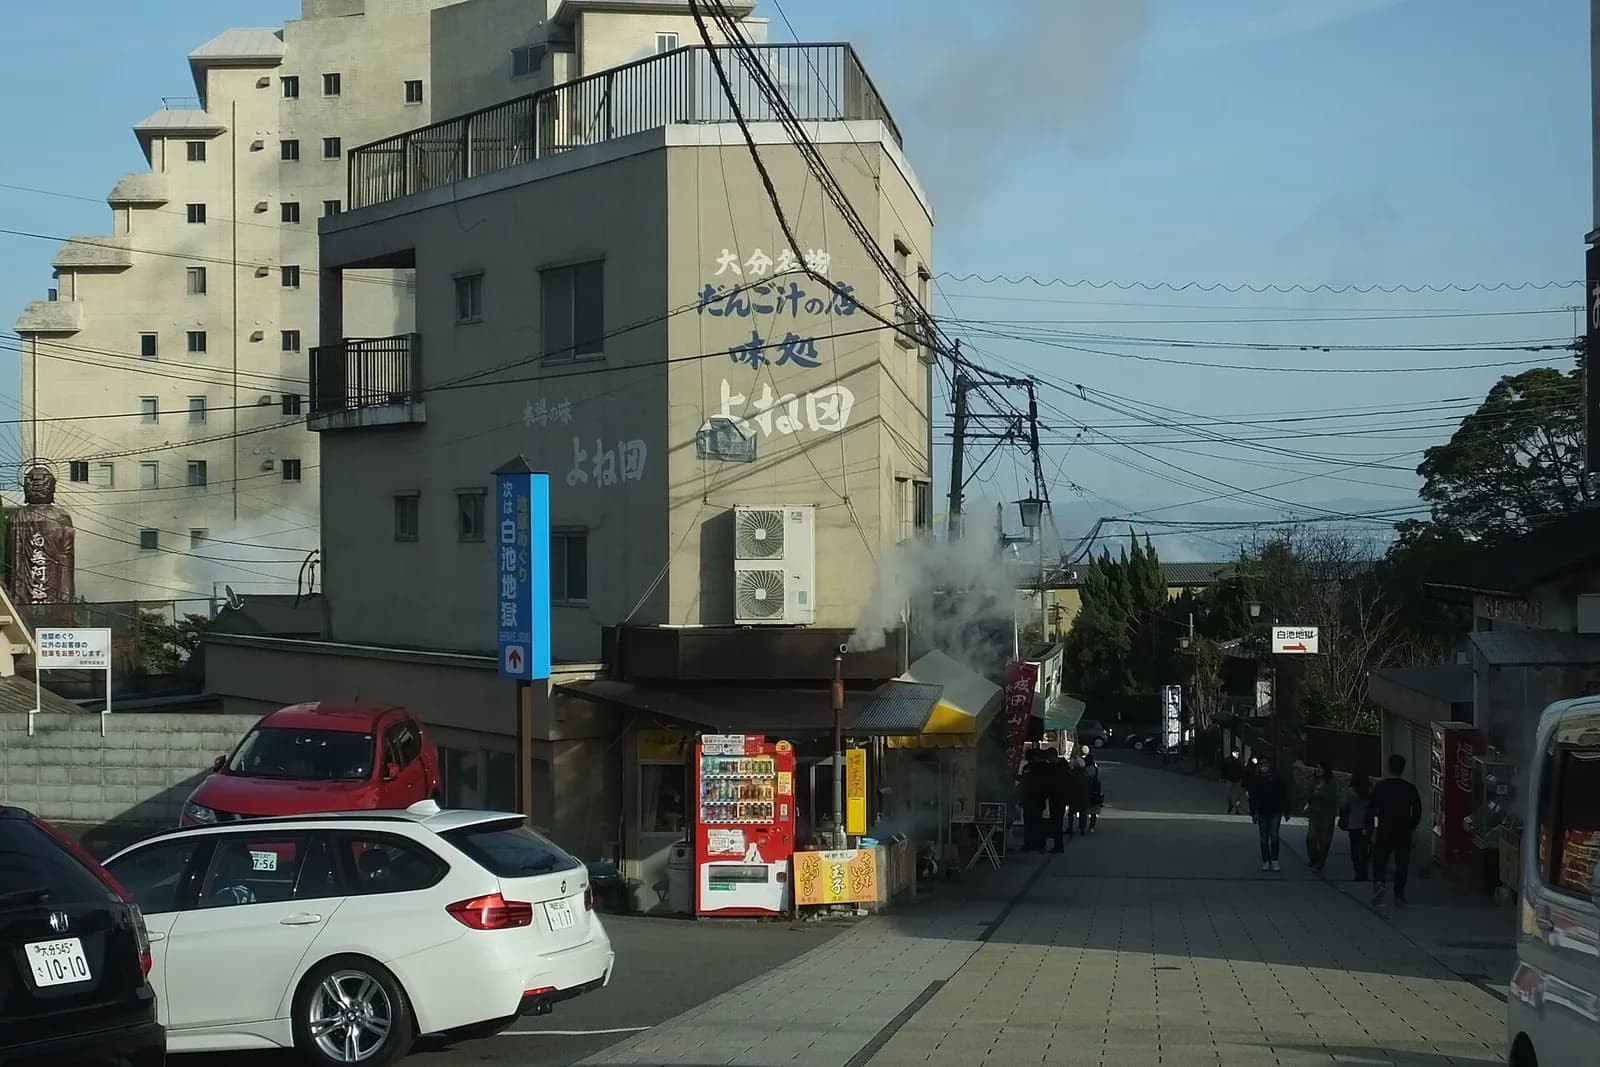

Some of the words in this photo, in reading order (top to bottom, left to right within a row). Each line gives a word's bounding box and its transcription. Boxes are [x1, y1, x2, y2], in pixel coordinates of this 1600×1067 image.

[697, 281, 858, 318] だんご汁の店
[728, 330, 822, 370] 味処
[1277, 631, 1314, 639] 白池地獄
